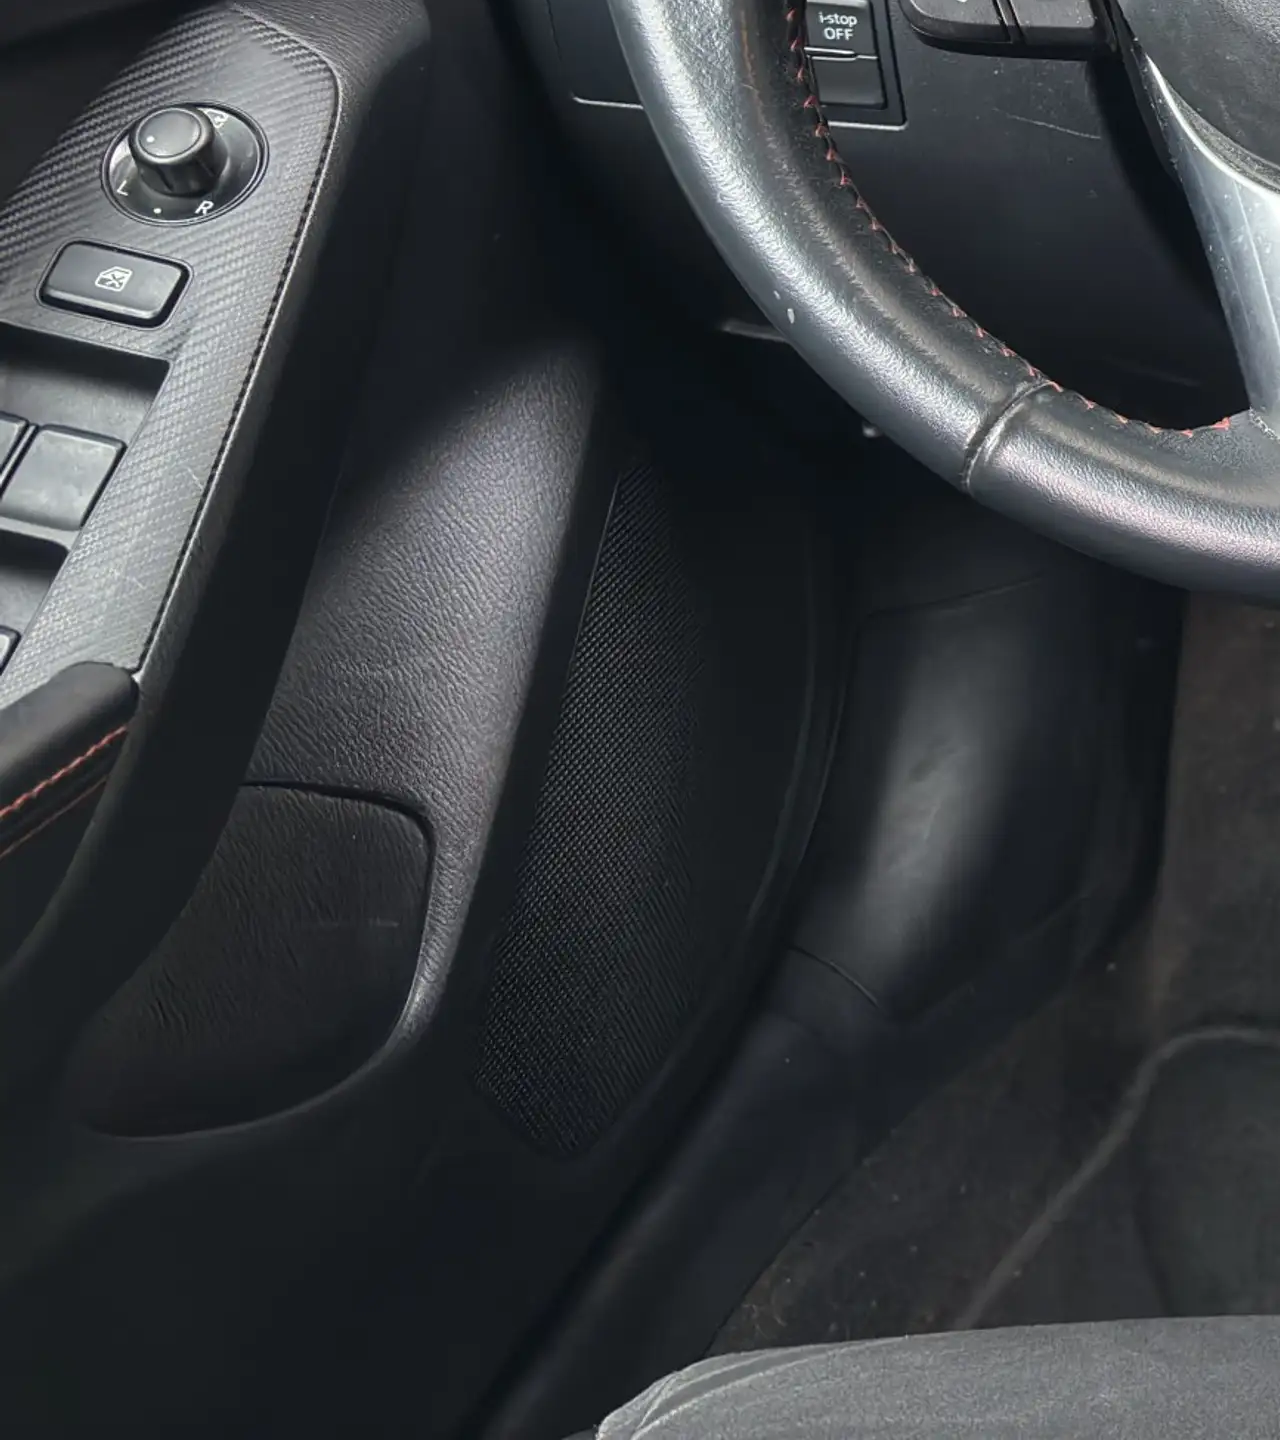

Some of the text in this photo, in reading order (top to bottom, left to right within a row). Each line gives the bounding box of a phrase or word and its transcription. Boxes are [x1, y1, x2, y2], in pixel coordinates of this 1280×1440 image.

[819, 11, 857, 27] i-stop
[824, 27, 853, 40] OFF
[116, 180, 128, 196] L
[195, 200, 214, 214] R
